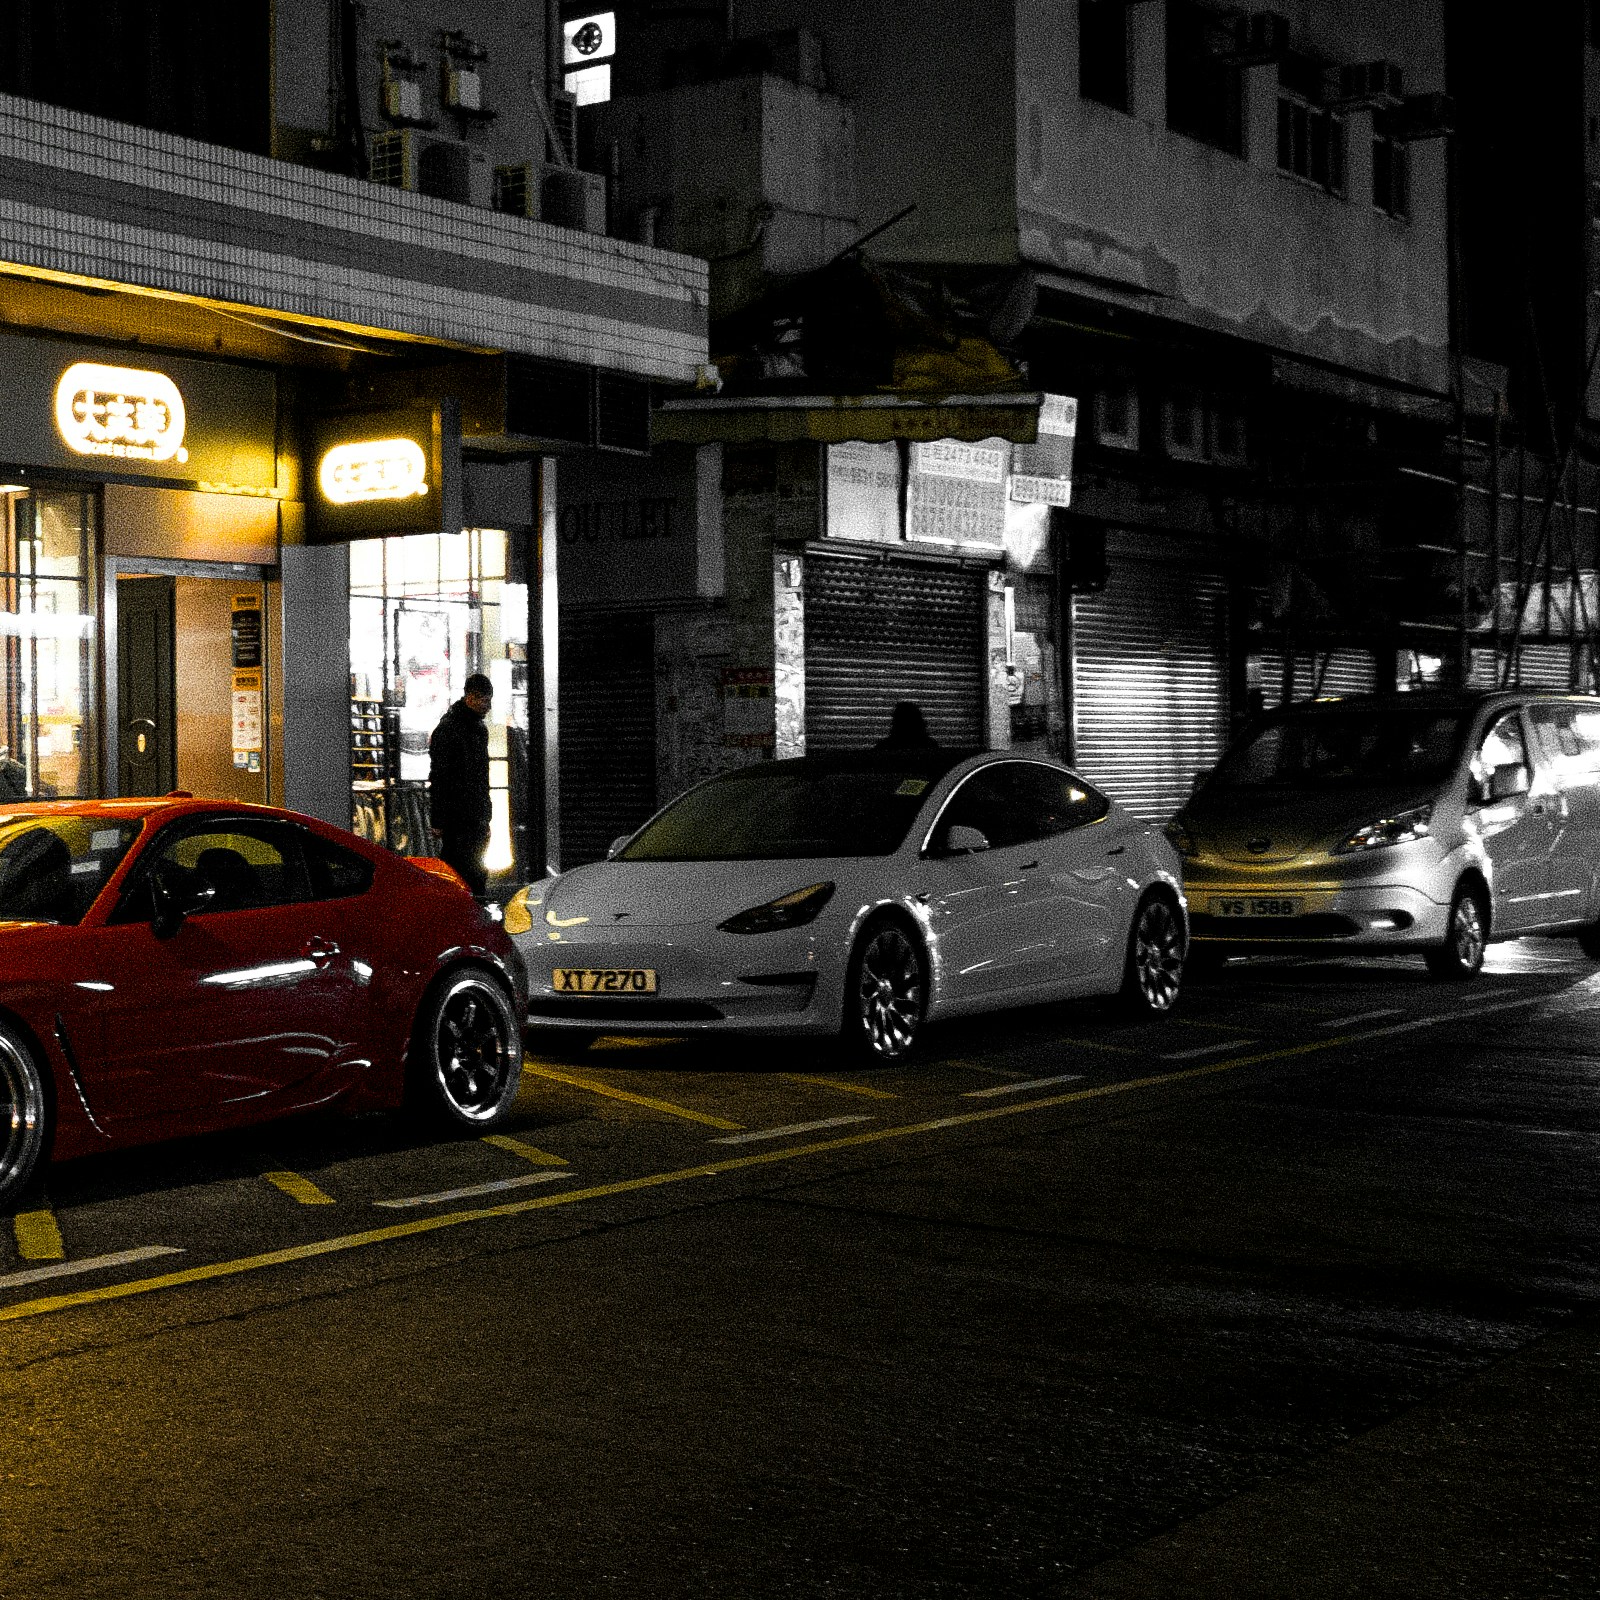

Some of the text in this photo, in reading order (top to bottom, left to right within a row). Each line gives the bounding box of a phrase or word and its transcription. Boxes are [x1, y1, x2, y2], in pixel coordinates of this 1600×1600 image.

[560, 496, 678, 544] OULET
[561, 970, 648, 991] XT 7270
